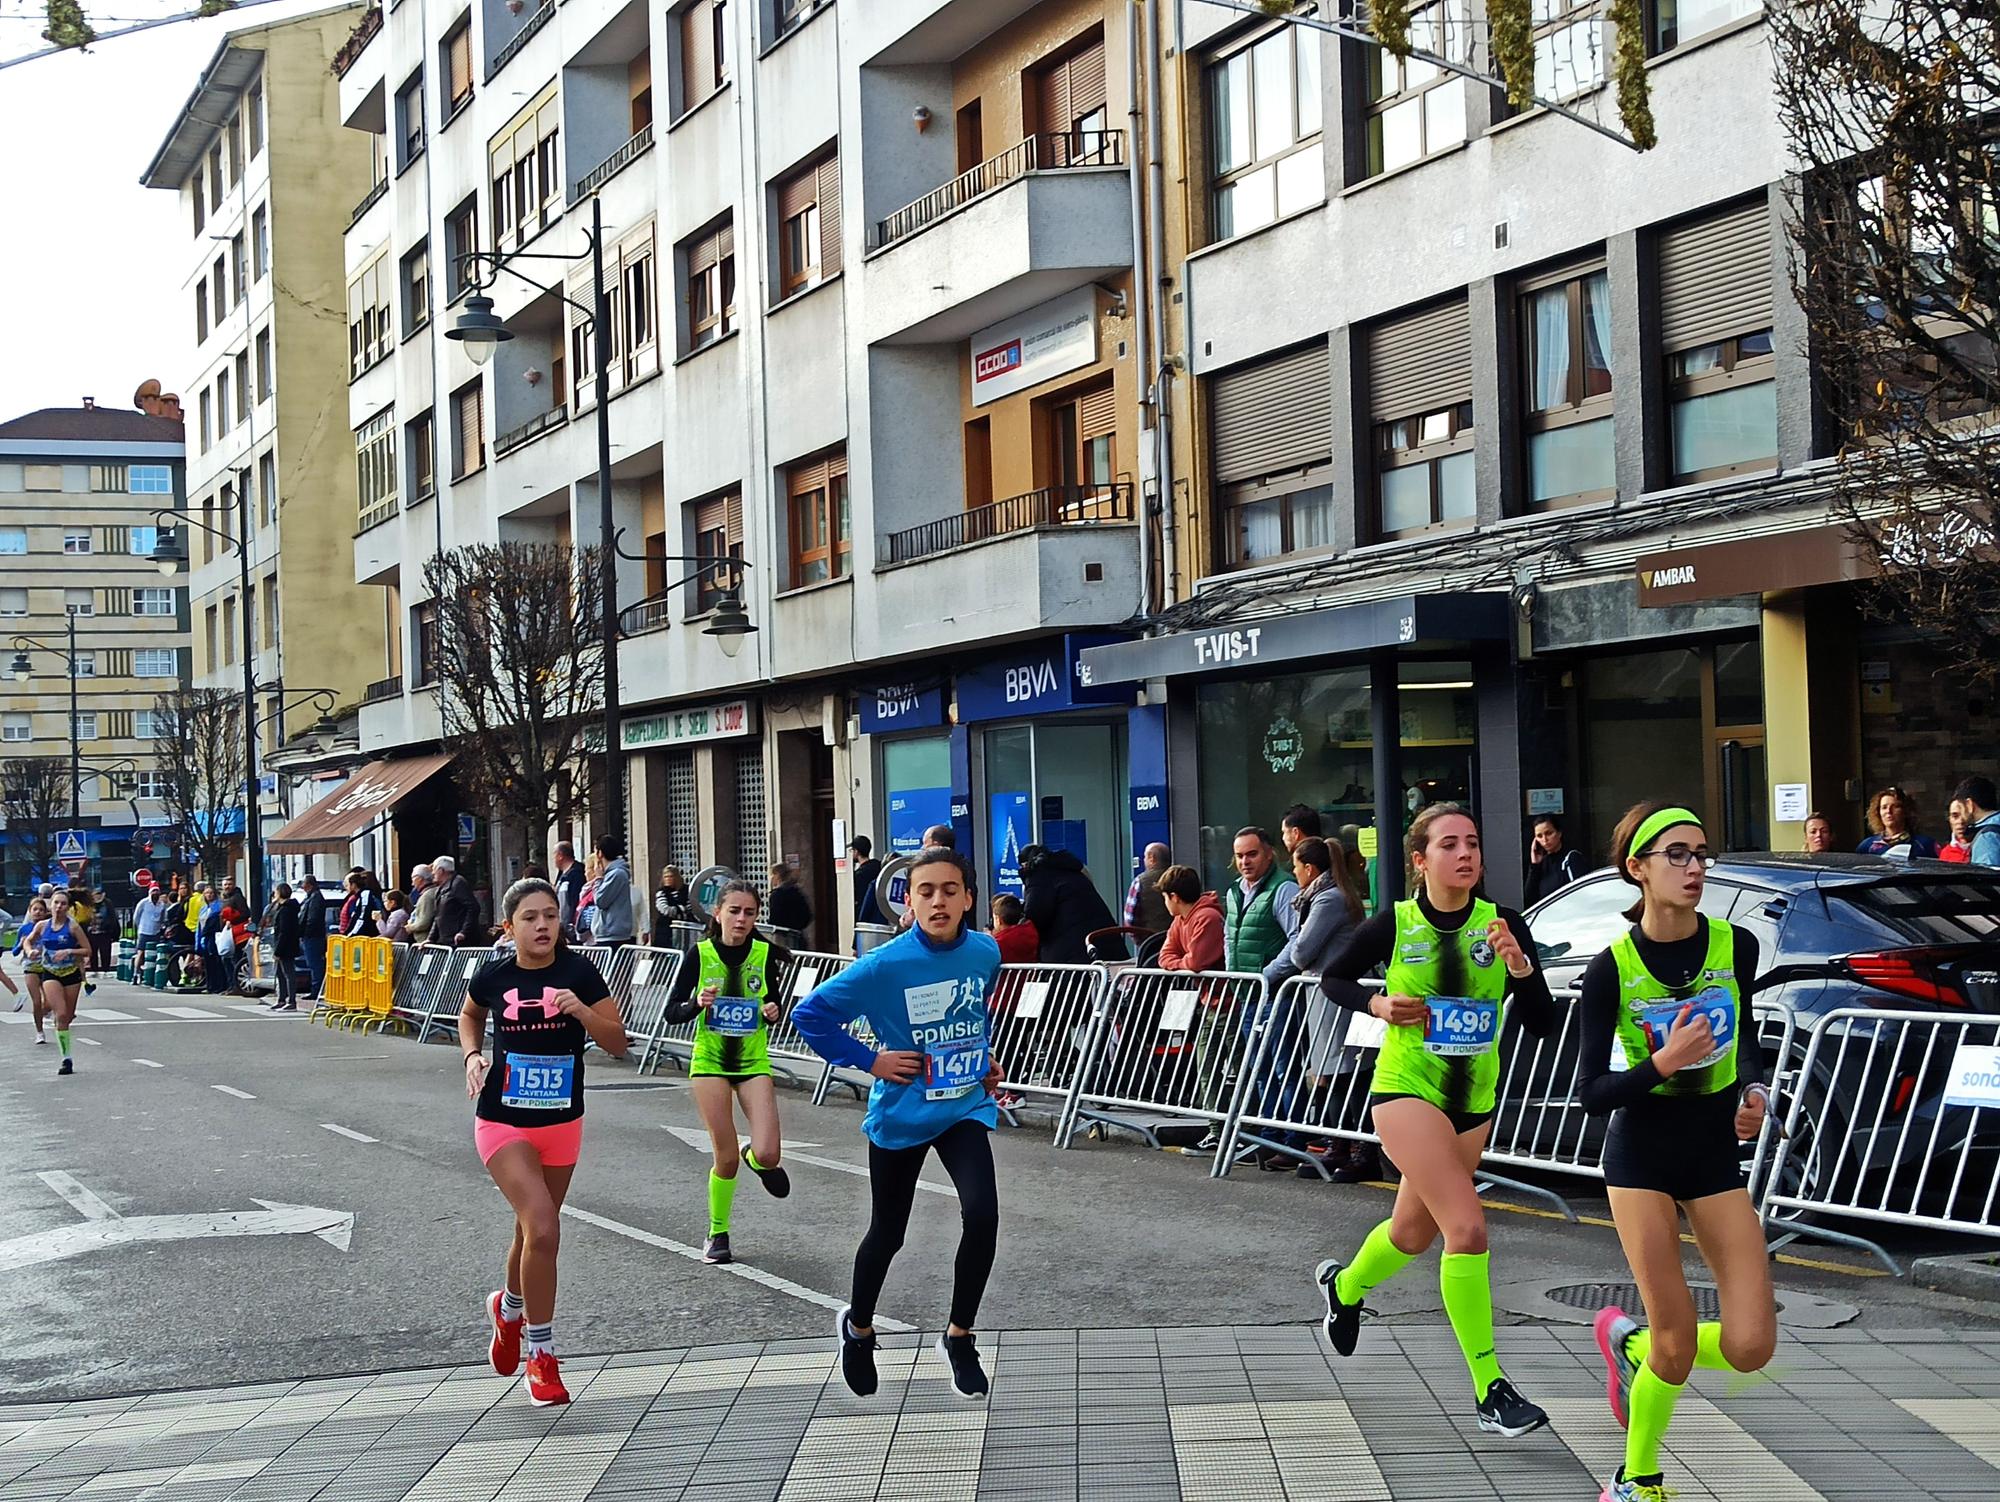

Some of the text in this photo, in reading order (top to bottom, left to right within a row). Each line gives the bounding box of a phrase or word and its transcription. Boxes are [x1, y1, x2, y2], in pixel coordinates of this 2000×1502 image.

[977, 349, 1008, 377] CCOO
[1652, 564, 1696, 588] AMBAR
[1194, 628, 1261, 664] T-VIS-T
[1005, 658, 1058, 702] BBVA
[877, 682, 919, 719] BBVA
[951, 804, 968, 817] BBVA
[1136, 795, 1159, 811] BBVA
[711, 1004, 753, 1023] 1469
[1431, 1008, 1492, 1034] 1498
[1450, 1034, 1477, 1042] PAULA
[1655, 1008, 1728, 1047] 12
[932, 1049, 984, 1078] 1477
[517, 1068, 564, 1089] 1513
[518, 1088, 560, 1097] CAYETANA
